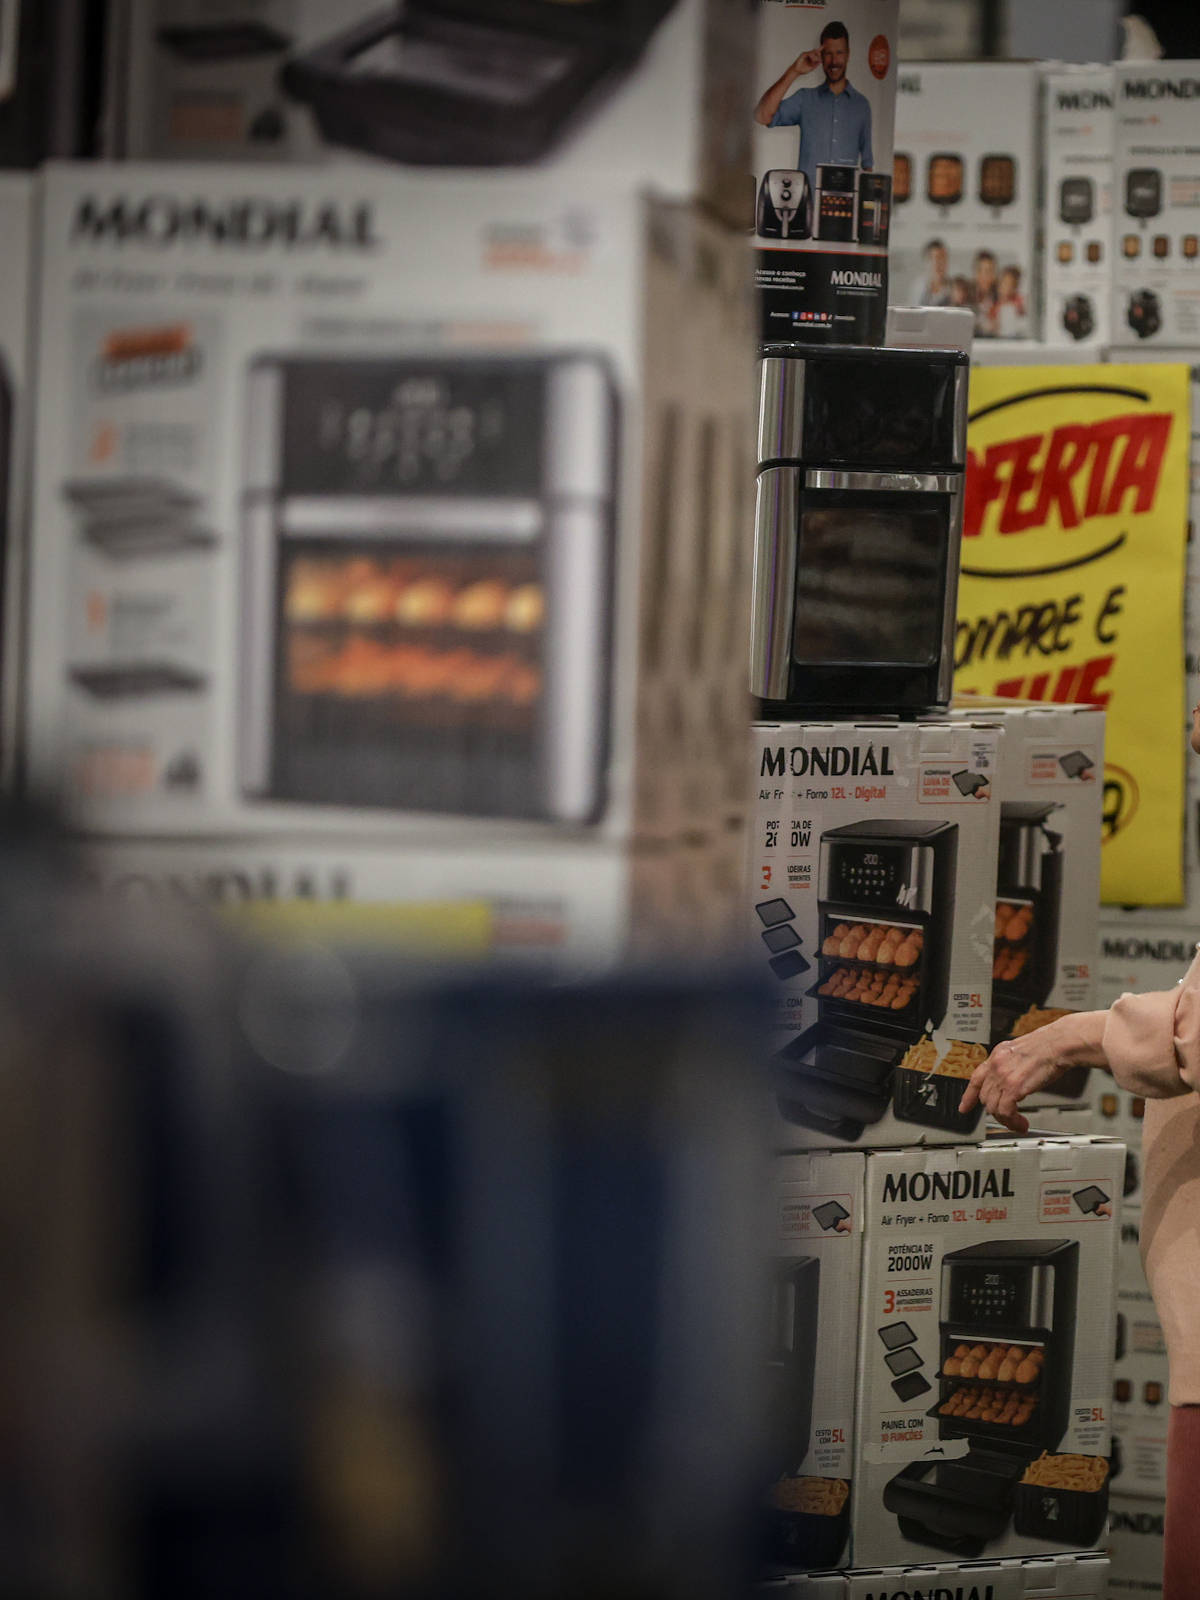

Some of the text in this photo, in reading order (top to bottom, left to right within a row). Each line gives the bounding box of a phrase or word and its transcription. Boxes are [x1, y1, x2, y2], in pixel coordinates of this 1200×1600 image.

[70, 196, 381, 252] MONDIAL
[830, 270, 882, 287] MONDIAL
[1095, 584, 1126, 645] E
[760, 745, 894, 777] MONDIAL
[806, 788, 828, 800] Forno
[831, 787, 846, 799] 12L
[855, 785, 887, 802] Digital
[882, 1167, 1015, 1203] MONDIAL
[881, 1215, 892, 1226] Air
[895, 1214, 916, 1228] Fryer
[927, 1213, 949, 1224] Forno
[952, 1209, 968, 1222] 12L
[975, 1207, 1008, 1224] Digital
[924, 1243, 933, 1253] DE
[887, 1254, 933, 1272] 2000W
[896, 1287, 933, 1297] ASSADEIRAS
[882, 1289, 895, 1314] 3
[1091, 1407, 1105, 1422] 5L
[881, 1418, 924, 1431] PAINEL COM
[831, 1428, 845, 1443] 5L
